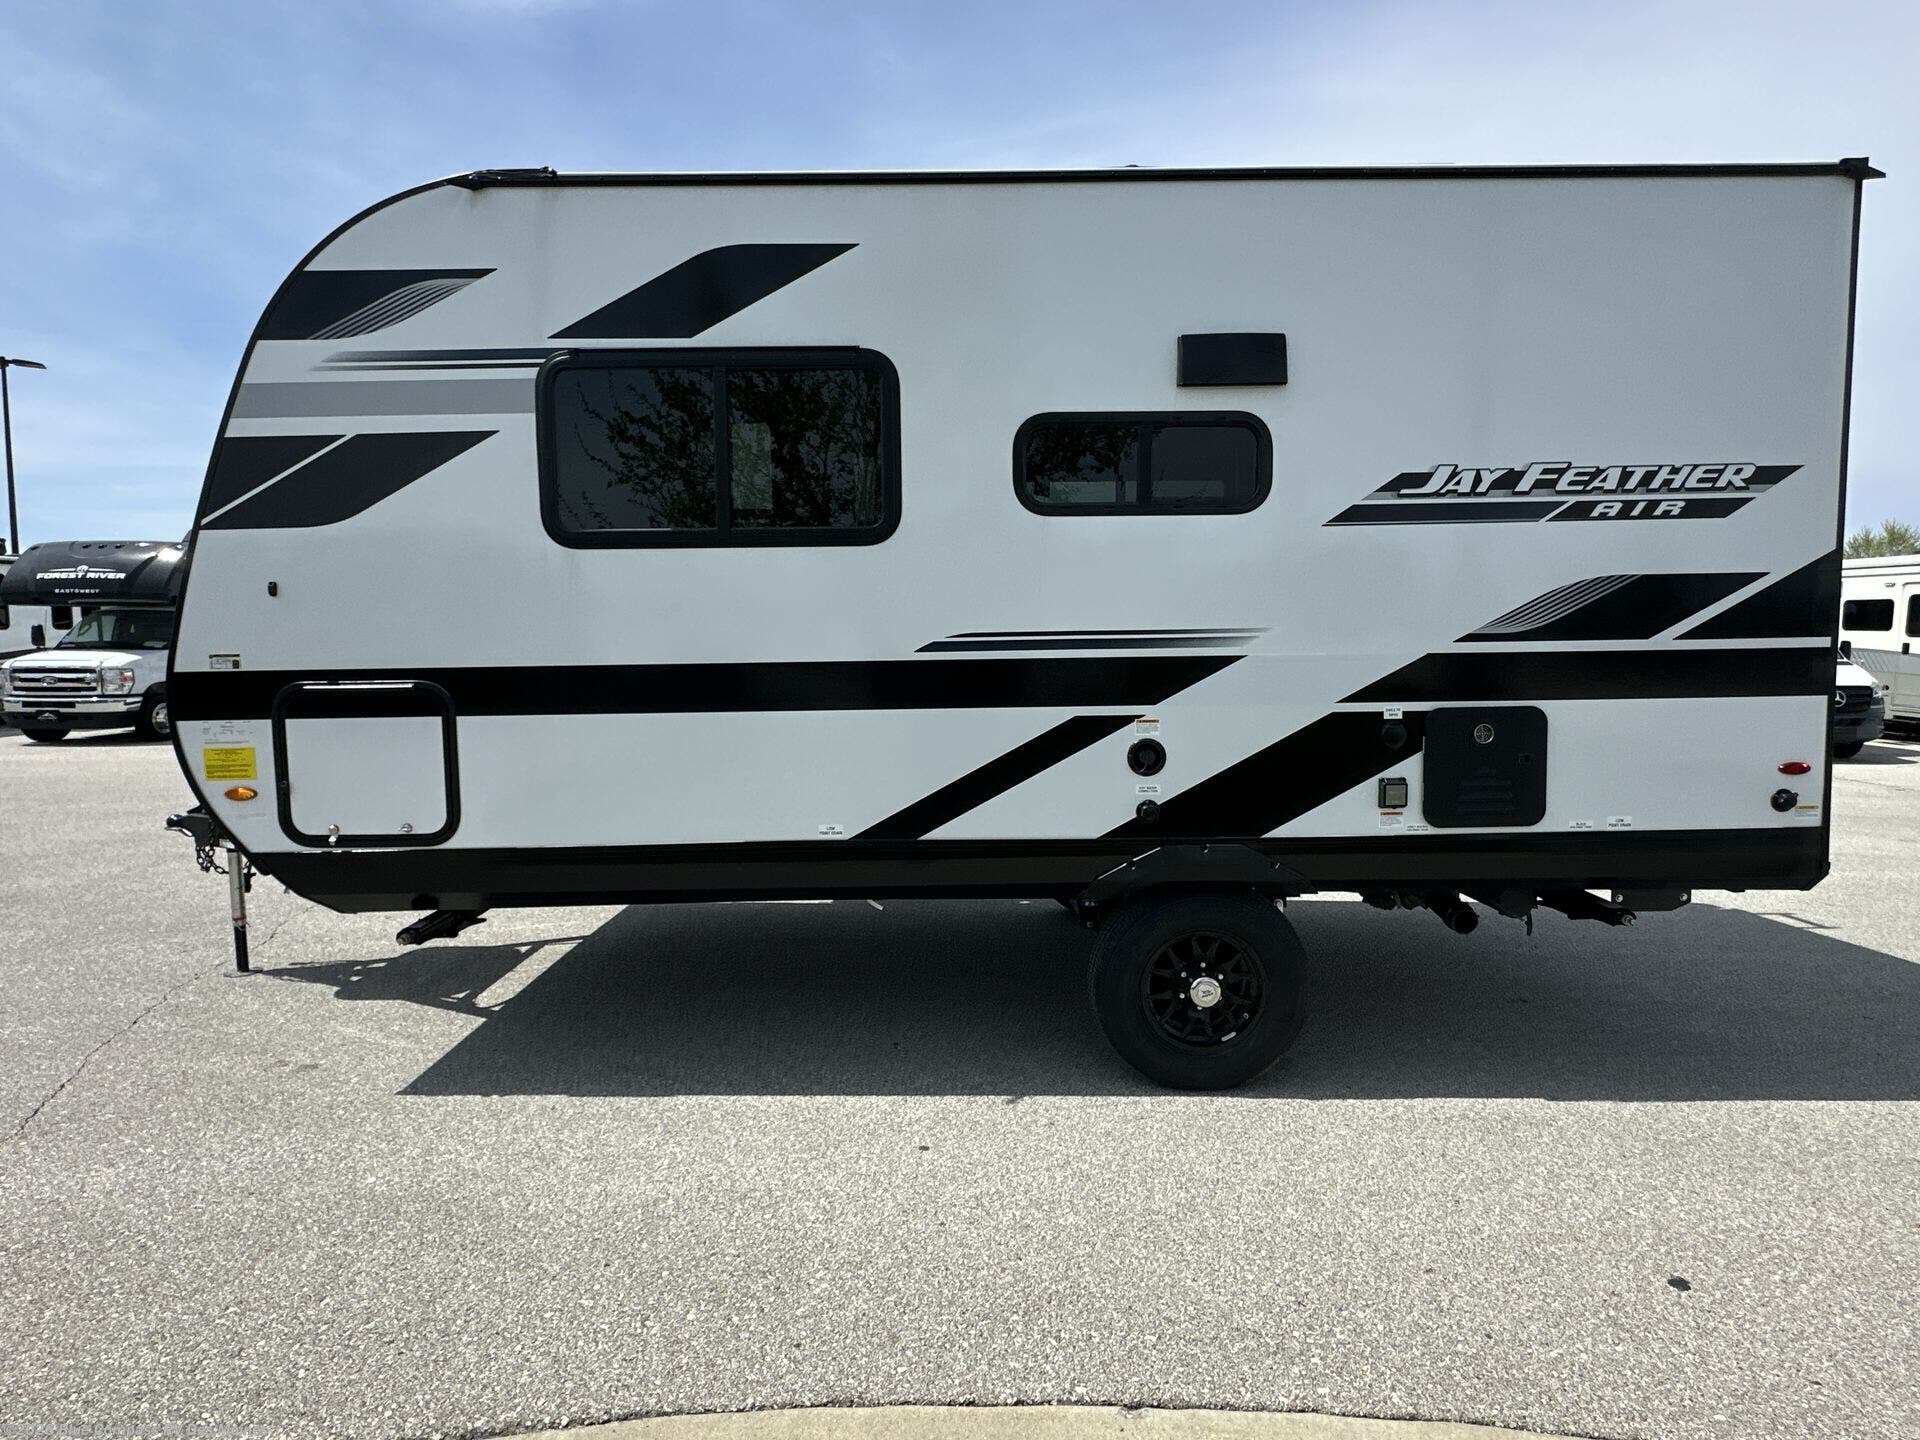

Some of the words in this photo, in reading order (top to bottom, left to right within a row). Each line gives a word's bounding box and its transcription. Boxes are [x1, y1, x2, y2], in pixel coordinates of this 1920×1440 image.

[1399, 464, 1512, 496] JAY
[1513, 462, 1757, 495] FEATHER
[1589, 500, 1687, 517] AIR
[36, 572, 85, 580] FOREST
